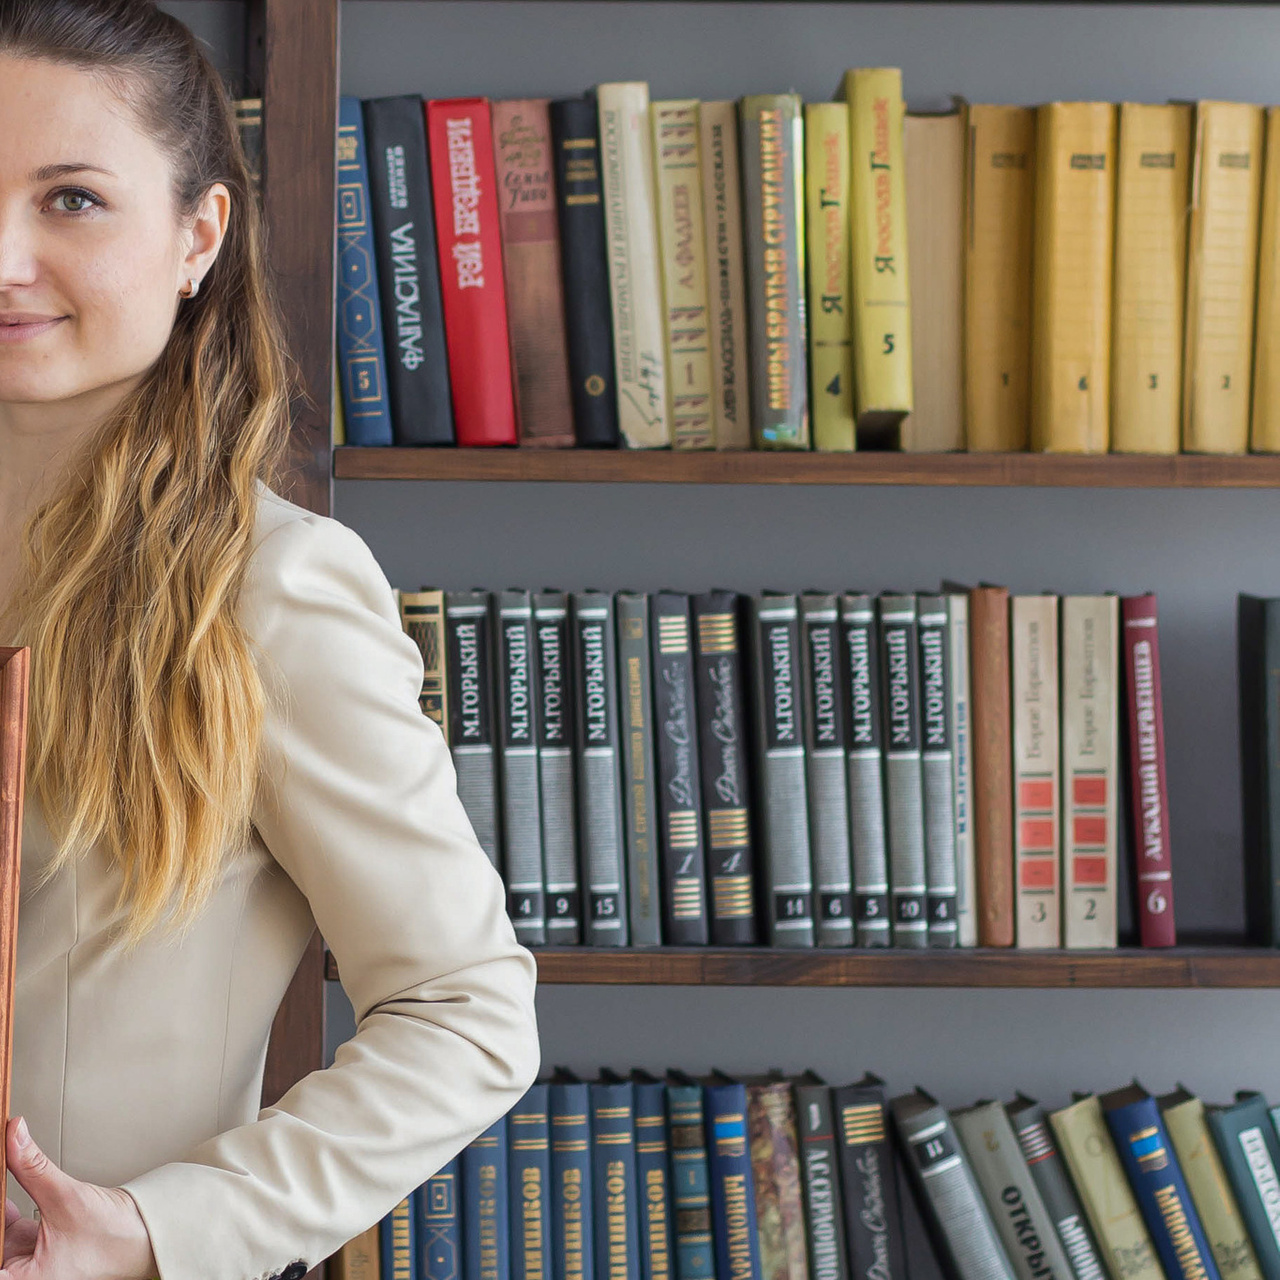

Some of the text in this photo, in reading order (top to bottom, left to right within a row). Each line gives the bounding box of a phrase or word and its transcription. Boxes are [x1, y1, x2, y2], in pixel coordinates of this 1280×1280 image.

[447, 118, 485, 290] РЭЙ БРЭДБЕРИ
[883, 334, 894, 353] 5
[456, 624, 481, 738] М.ГОРЬКИЙ
[582, 626, 606, 741] М.ГОРЬКИЙ
[557, 898, 569, 914] 9
[597, 899, 614, 915] 15
[1031, 902, 1046, 922] 3
[1084, 899, 1097, 920] 2
[1146, 894, 1166, 914] 6
